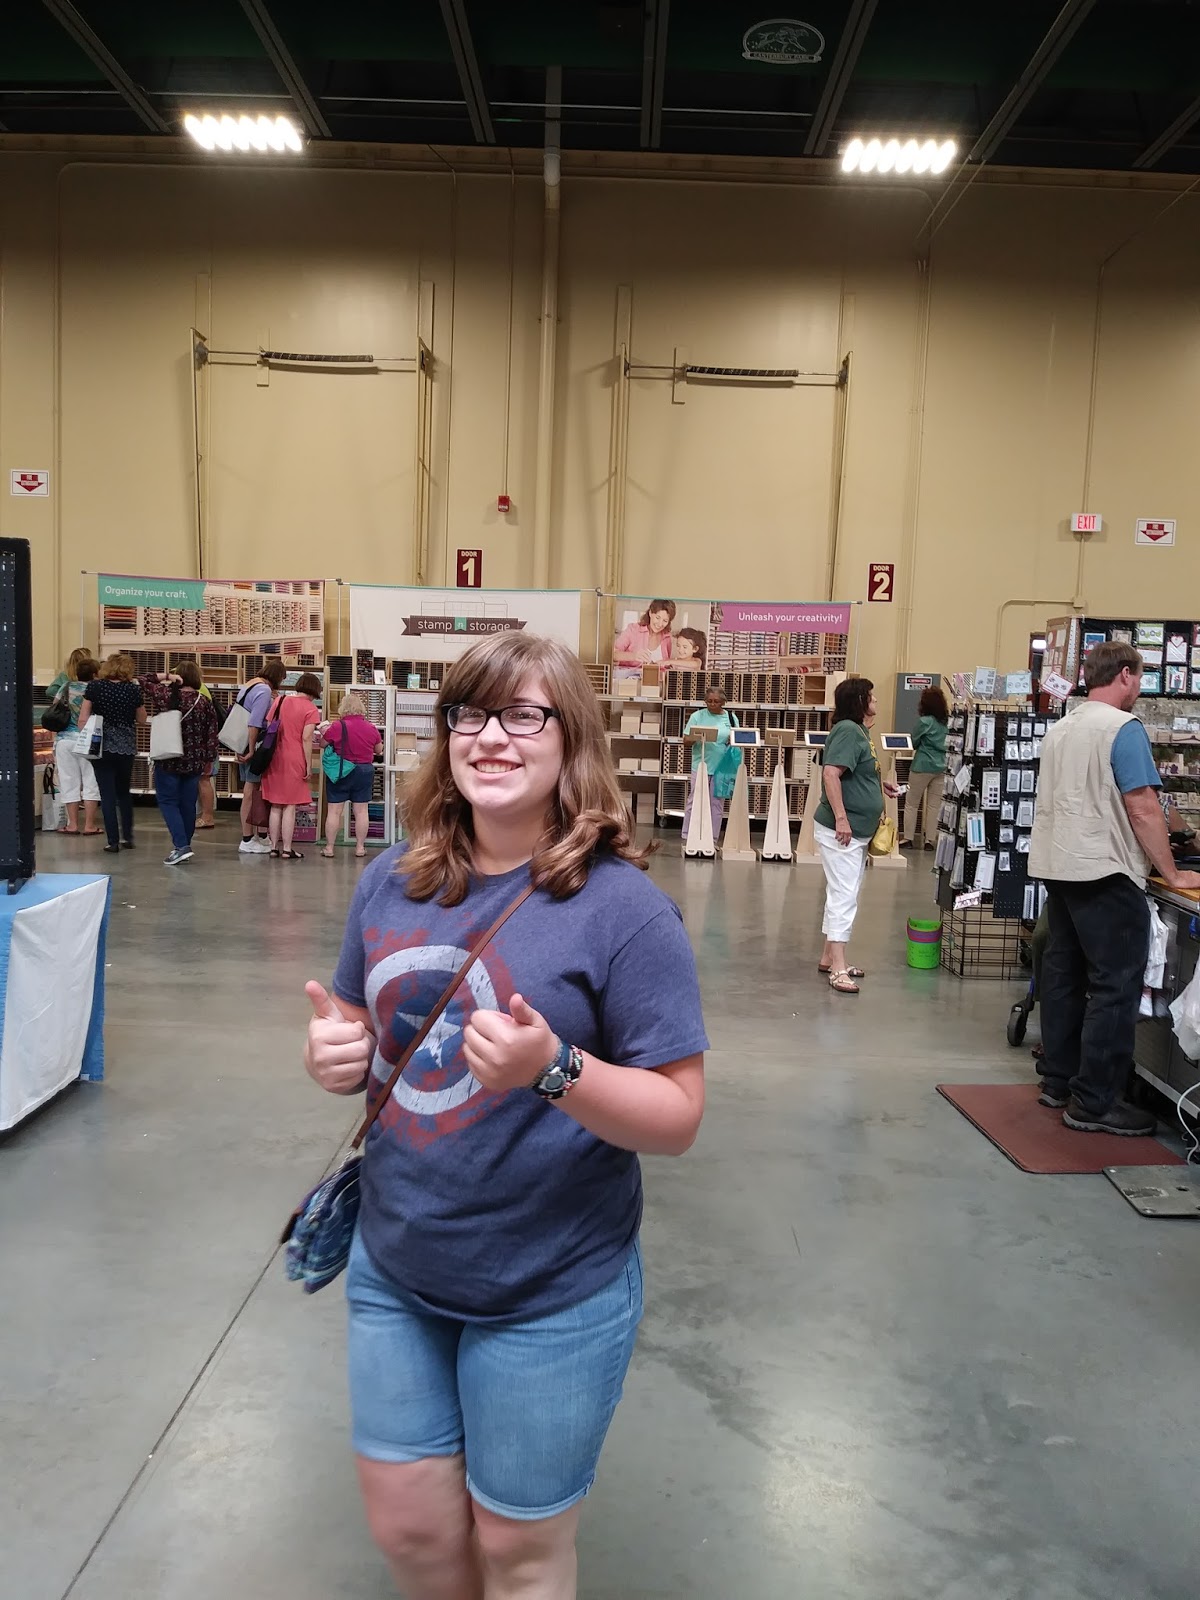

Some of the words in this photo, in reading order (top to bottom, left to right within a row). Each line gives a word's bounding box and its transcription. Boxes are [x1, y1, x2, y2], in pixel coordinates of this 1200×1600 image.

[1077, 515, 1096, 529] EXIT
[462, 558, 475, 586] 1
[104, 585, 143, 596] Organize
[144, 589, 164, 598] your
[165, 589, 188, 599] craft.
[872, 572, 890, 600] 2
[738, 612, 773, 621] Unleash
[775, 614, 795, 623] your
[797, 613, 843, 624] creativity!
[417, 620, 452, 632] stamp
[469, 622, 511, 631] storage
